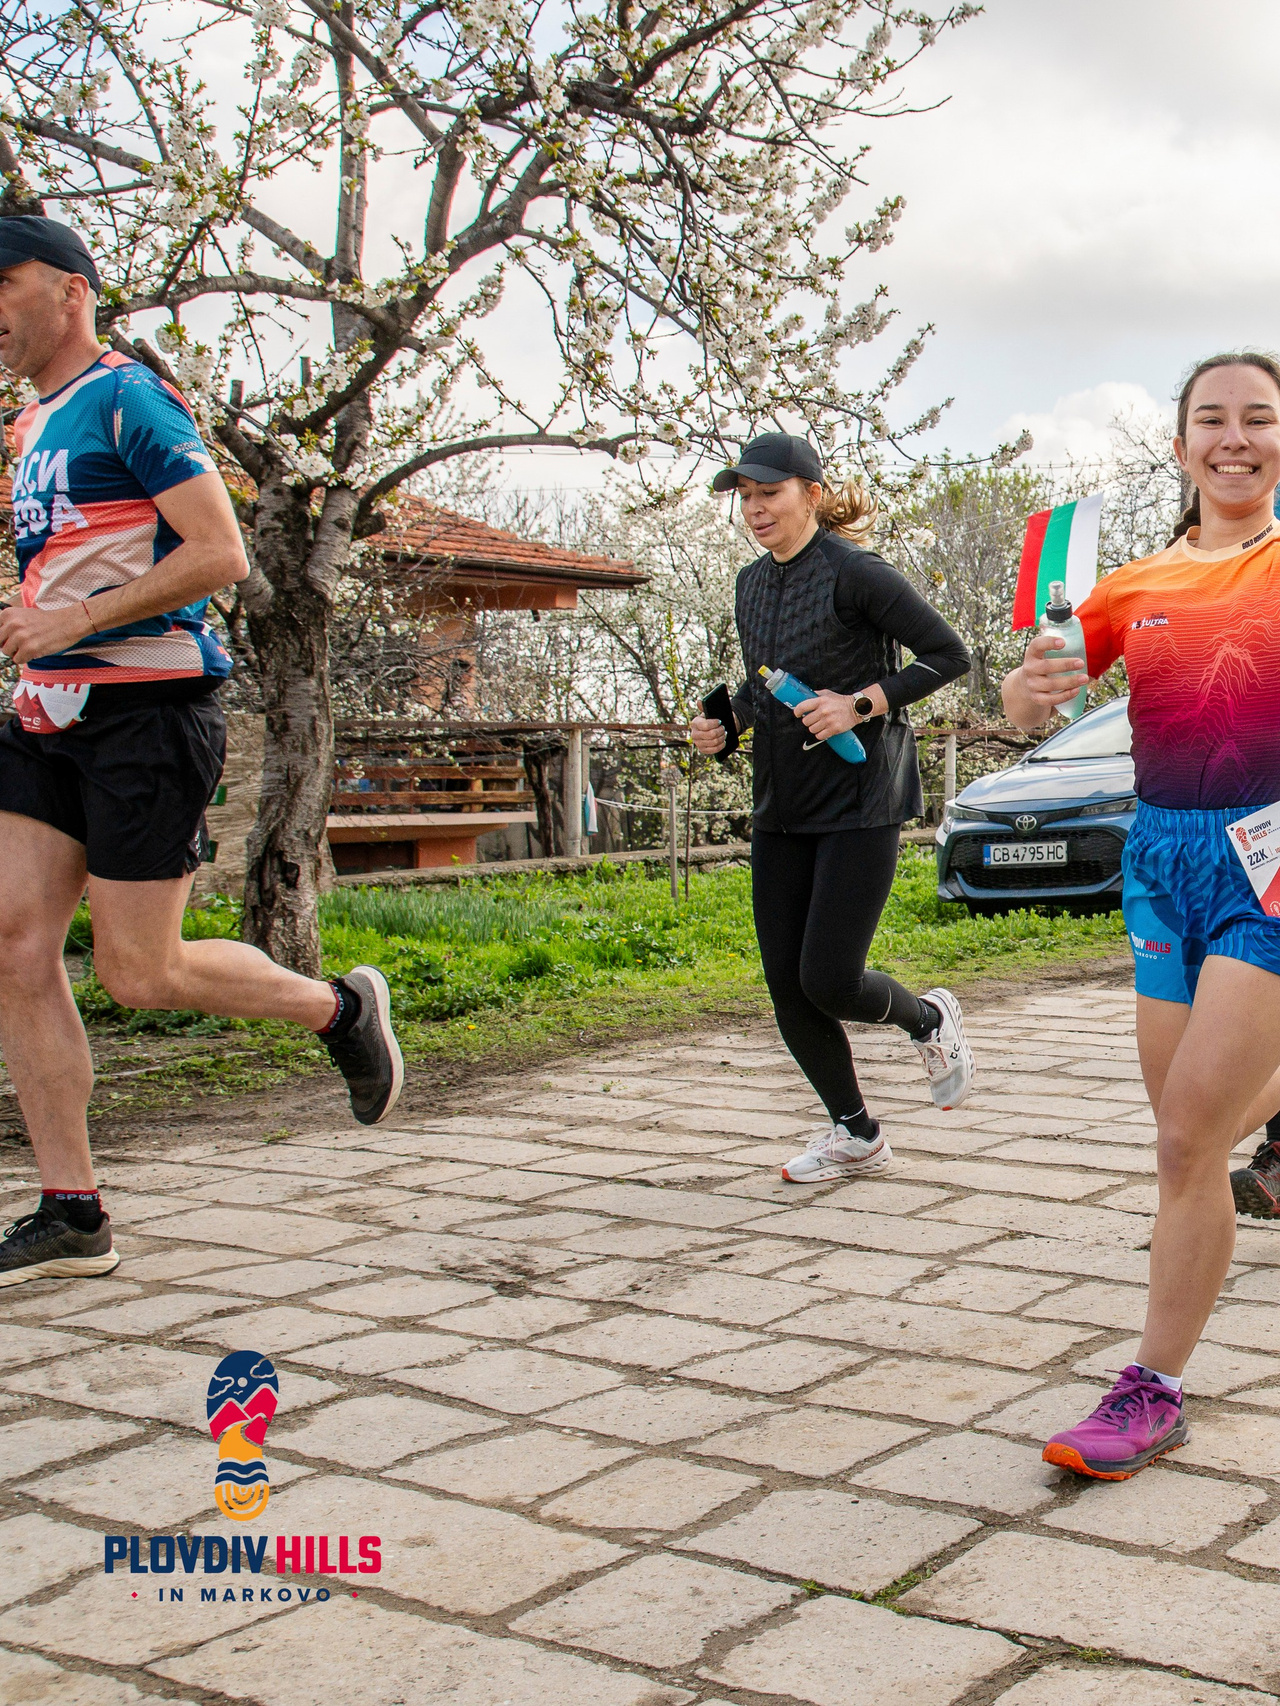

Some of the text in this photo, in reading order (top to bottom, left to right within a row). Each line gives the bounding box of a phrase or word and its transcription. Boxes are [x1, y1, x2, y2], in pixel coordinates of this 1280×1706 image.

[1248, 820, 1272, 836] PLOVDIV
[1251, 830, 1268, 842] HILLS
[993, 845, 1064, 862] CB 4795 HC
[1247, 848, 1268, 866] 22K
[1145, 940, 1171, 954] HILLS
